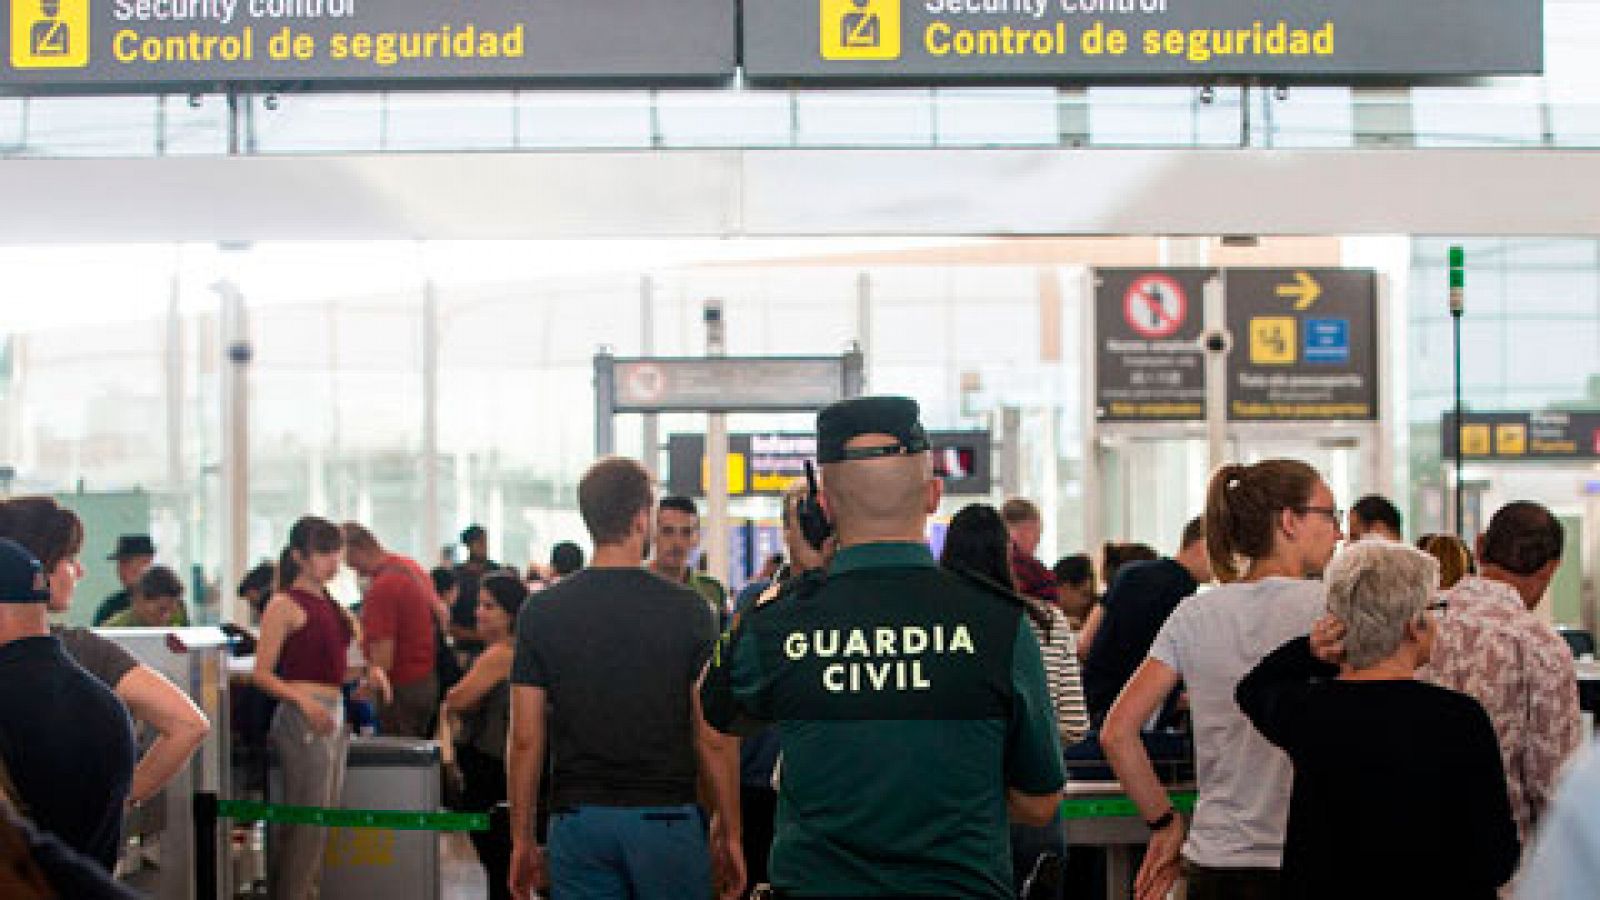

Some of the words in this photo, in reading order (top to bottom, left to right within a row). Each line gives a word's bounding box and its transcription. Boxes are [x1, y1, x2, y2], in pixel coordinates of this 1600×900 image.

[113, 26, 253, 62] Control
[269, 26, 315, 60] de
[330, 23, 524, 64] seguridad
[924, 20, 1066, 56] Control
[1081, 20, 1128, 55] de
[1143, 20, 1335, 62] seguridad
[784, 624, 974, 660] GUARDIA
[823, 660, 931, 691] CIVIL
